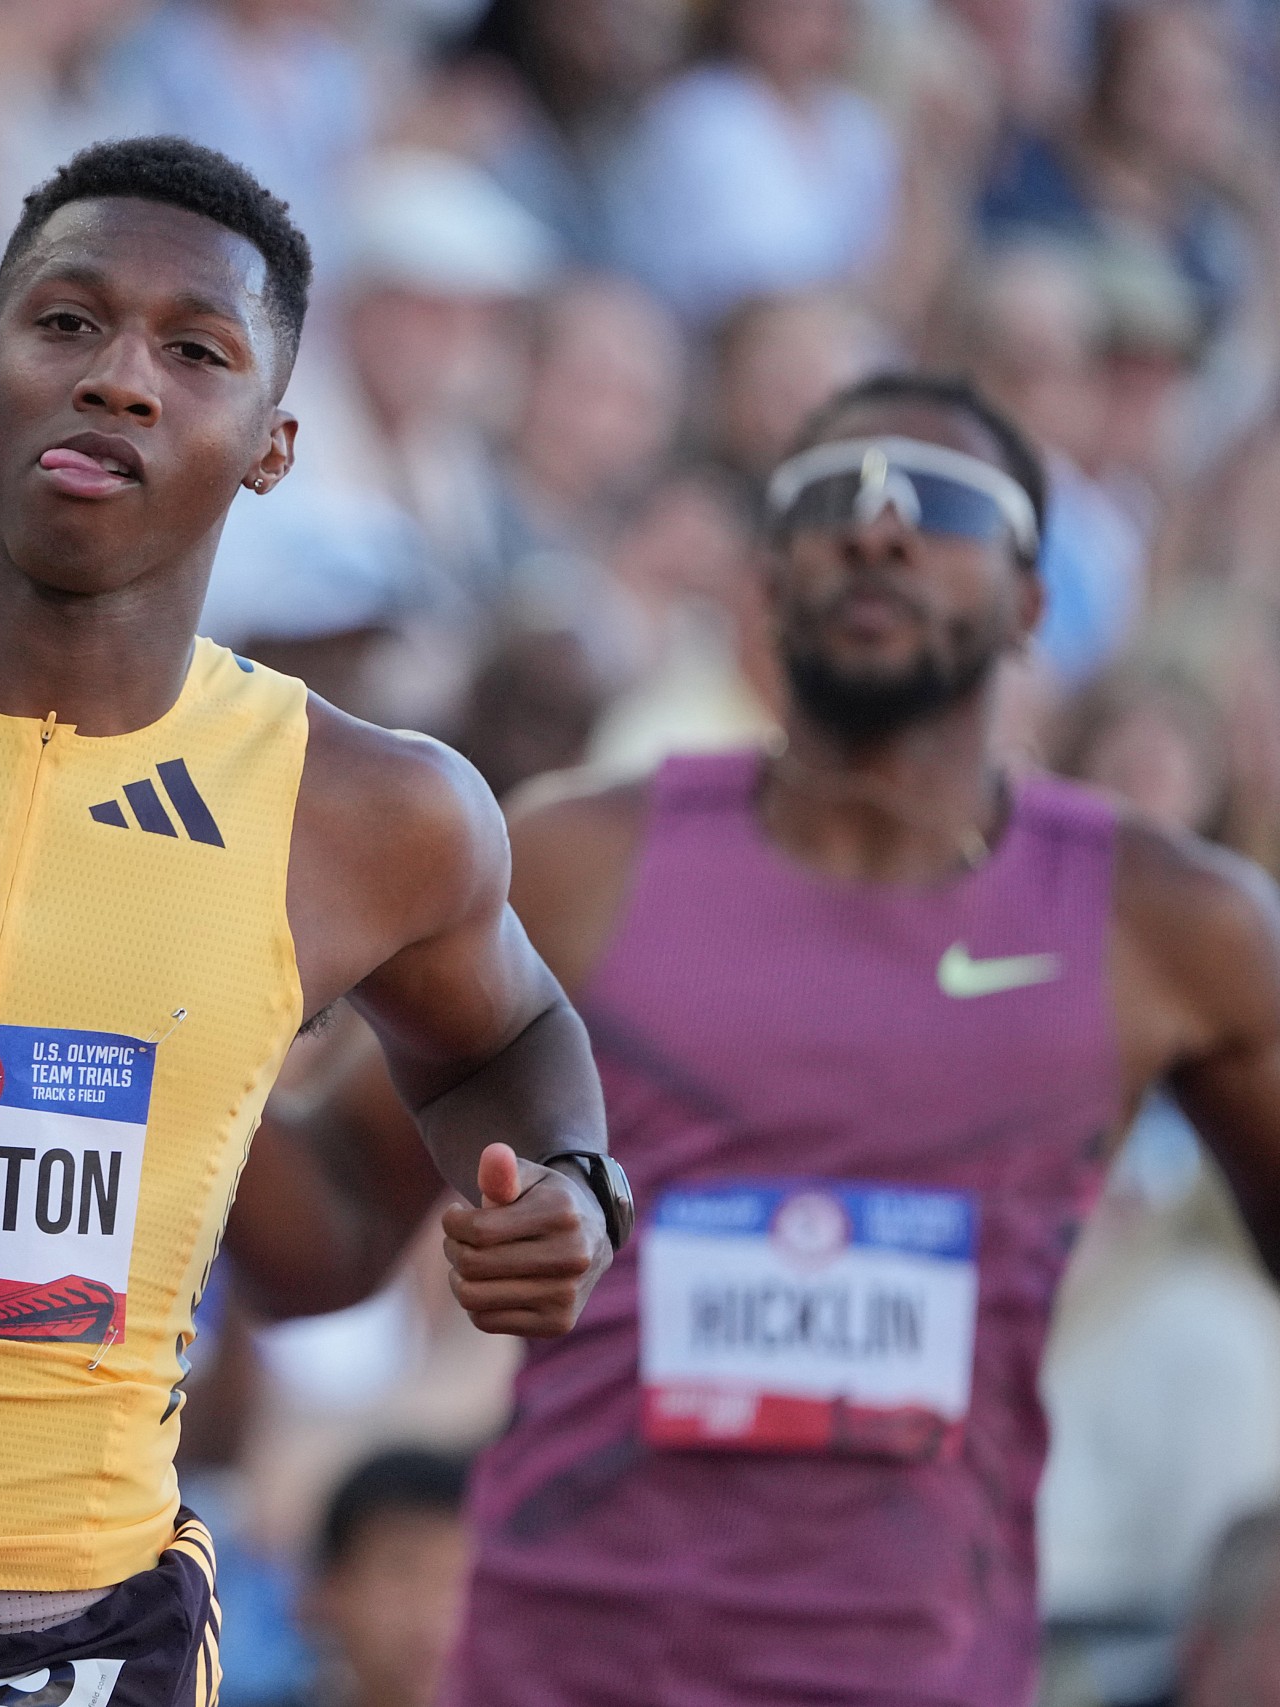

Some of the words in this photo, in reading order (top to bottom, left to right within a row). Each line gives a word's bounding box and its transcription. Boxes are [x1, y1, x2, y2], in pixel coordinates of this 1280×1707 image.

[33, 1041, 62, 1062] U.S.
[67, 1044, 135, 1066] OLYMPIC
[31, 1064, 73, 1085] TEAM
[77, 1066, 133, 1088] TRIALS
[32, 1086, 66, 1101] TRACK
[78, 1089, 106, 1103] FIELD
